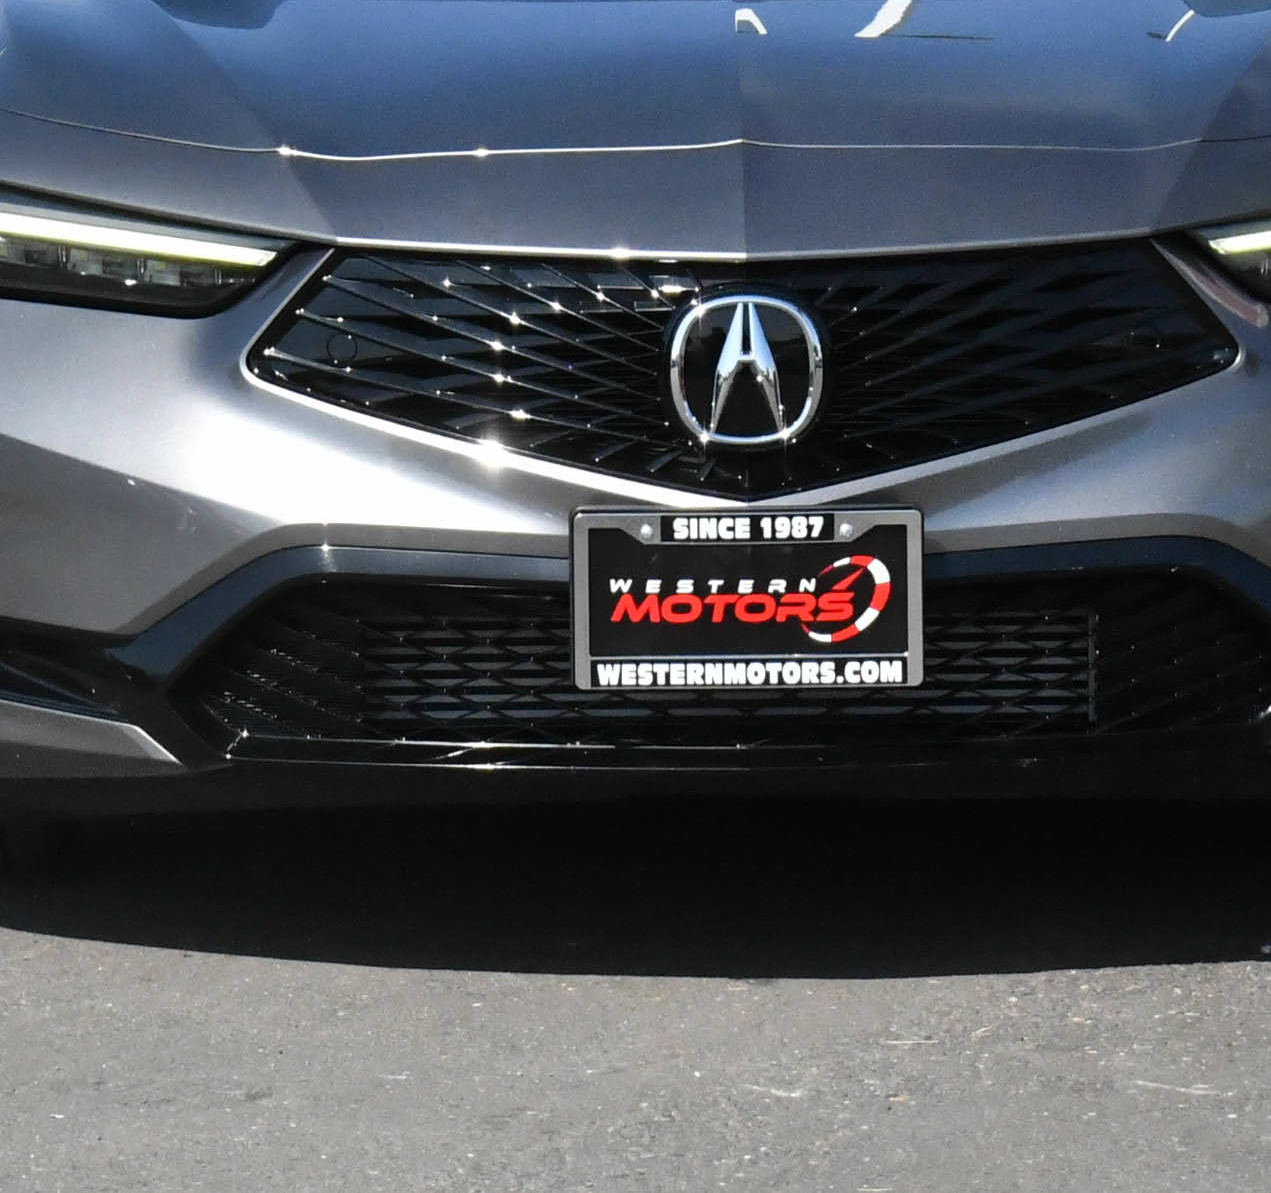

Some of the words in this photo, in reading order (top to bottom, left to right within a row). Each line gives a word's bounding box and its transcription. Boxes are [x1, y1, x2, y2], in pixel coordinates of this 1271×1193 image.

[672, 517, 751, 540] SINCE
[760, 515, 824, 539] 1987
[609, 577, 816, 594] WESTERN
[611, 591, 855, 623] MOTORS
[596, 660, 903, 687] WESTERNMOTORS.COM
